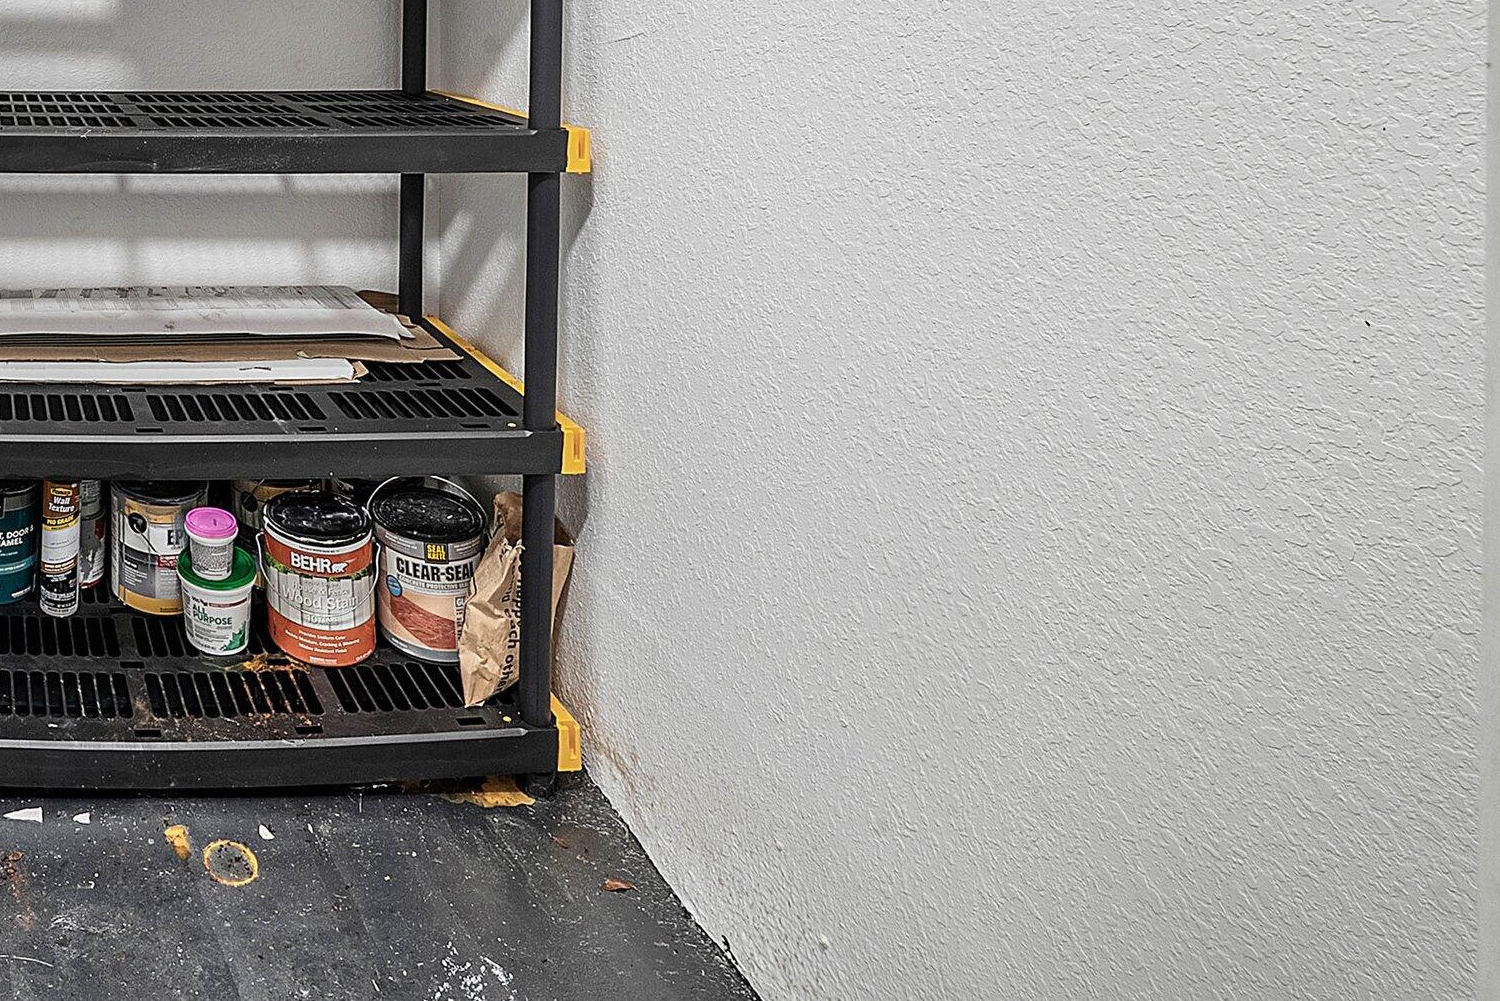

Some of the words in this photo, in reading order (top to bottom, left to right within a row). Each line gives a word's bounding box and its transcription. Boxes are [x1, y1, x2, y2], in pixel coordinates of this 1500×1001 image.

[53, 496, 70, 505] Wall
[48, 502, 75, 513] Texture
[6, 528, 29, 539] DOOR
[426, 544, 445, 553] SEAL
[290, 551, 332, 574] BEHR
[282, 584, 322, 609] Wood
[326, 596, 359, 610] Stain
[192, 603, 207, 617] ALL
[193, 611, 232, 626] PURPOSE
